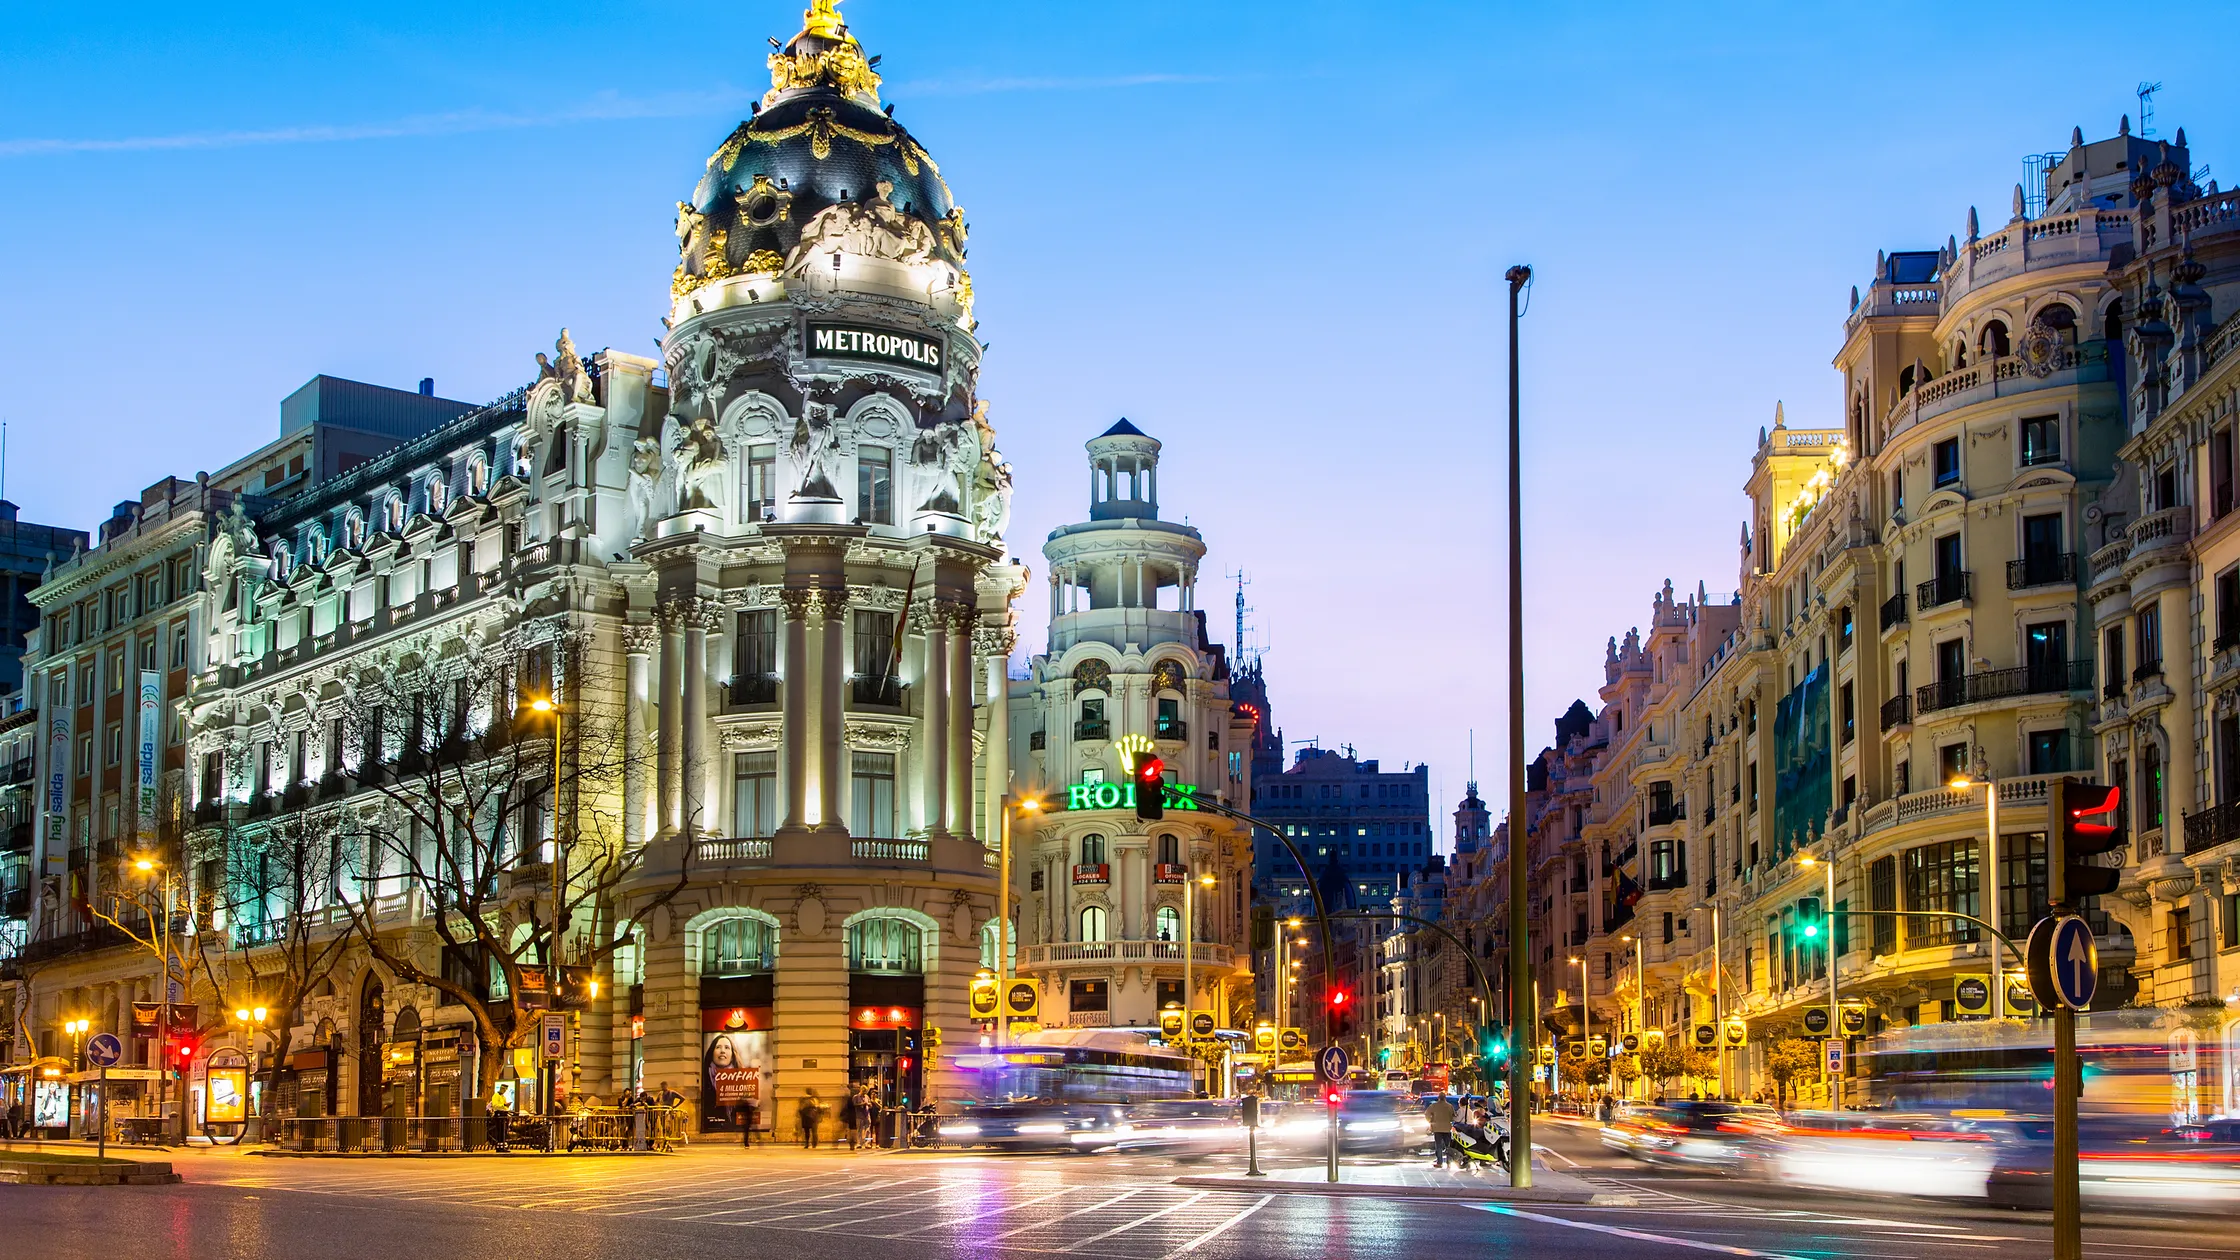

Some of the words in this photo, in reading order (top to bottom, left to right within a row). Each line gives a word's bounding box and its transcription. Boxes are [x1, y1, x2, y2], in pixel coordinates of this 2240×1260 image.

[816, 330, 939, 366] METROPOLIS
[140, 742, 154, 785] salida
[50, 773, 64, 813] salida
[138, 787, 156, 816] hay
[1067, 783, 1198, 810] ROLX
[49, 815, 66, 841] hay
[167, 982, 177, 1004] alida
[871, 1012, 913, 1023] Santander
[715, 1070, 761, 1082] CONFIAR
[725, 1084, 756, 1092] MILLONES
